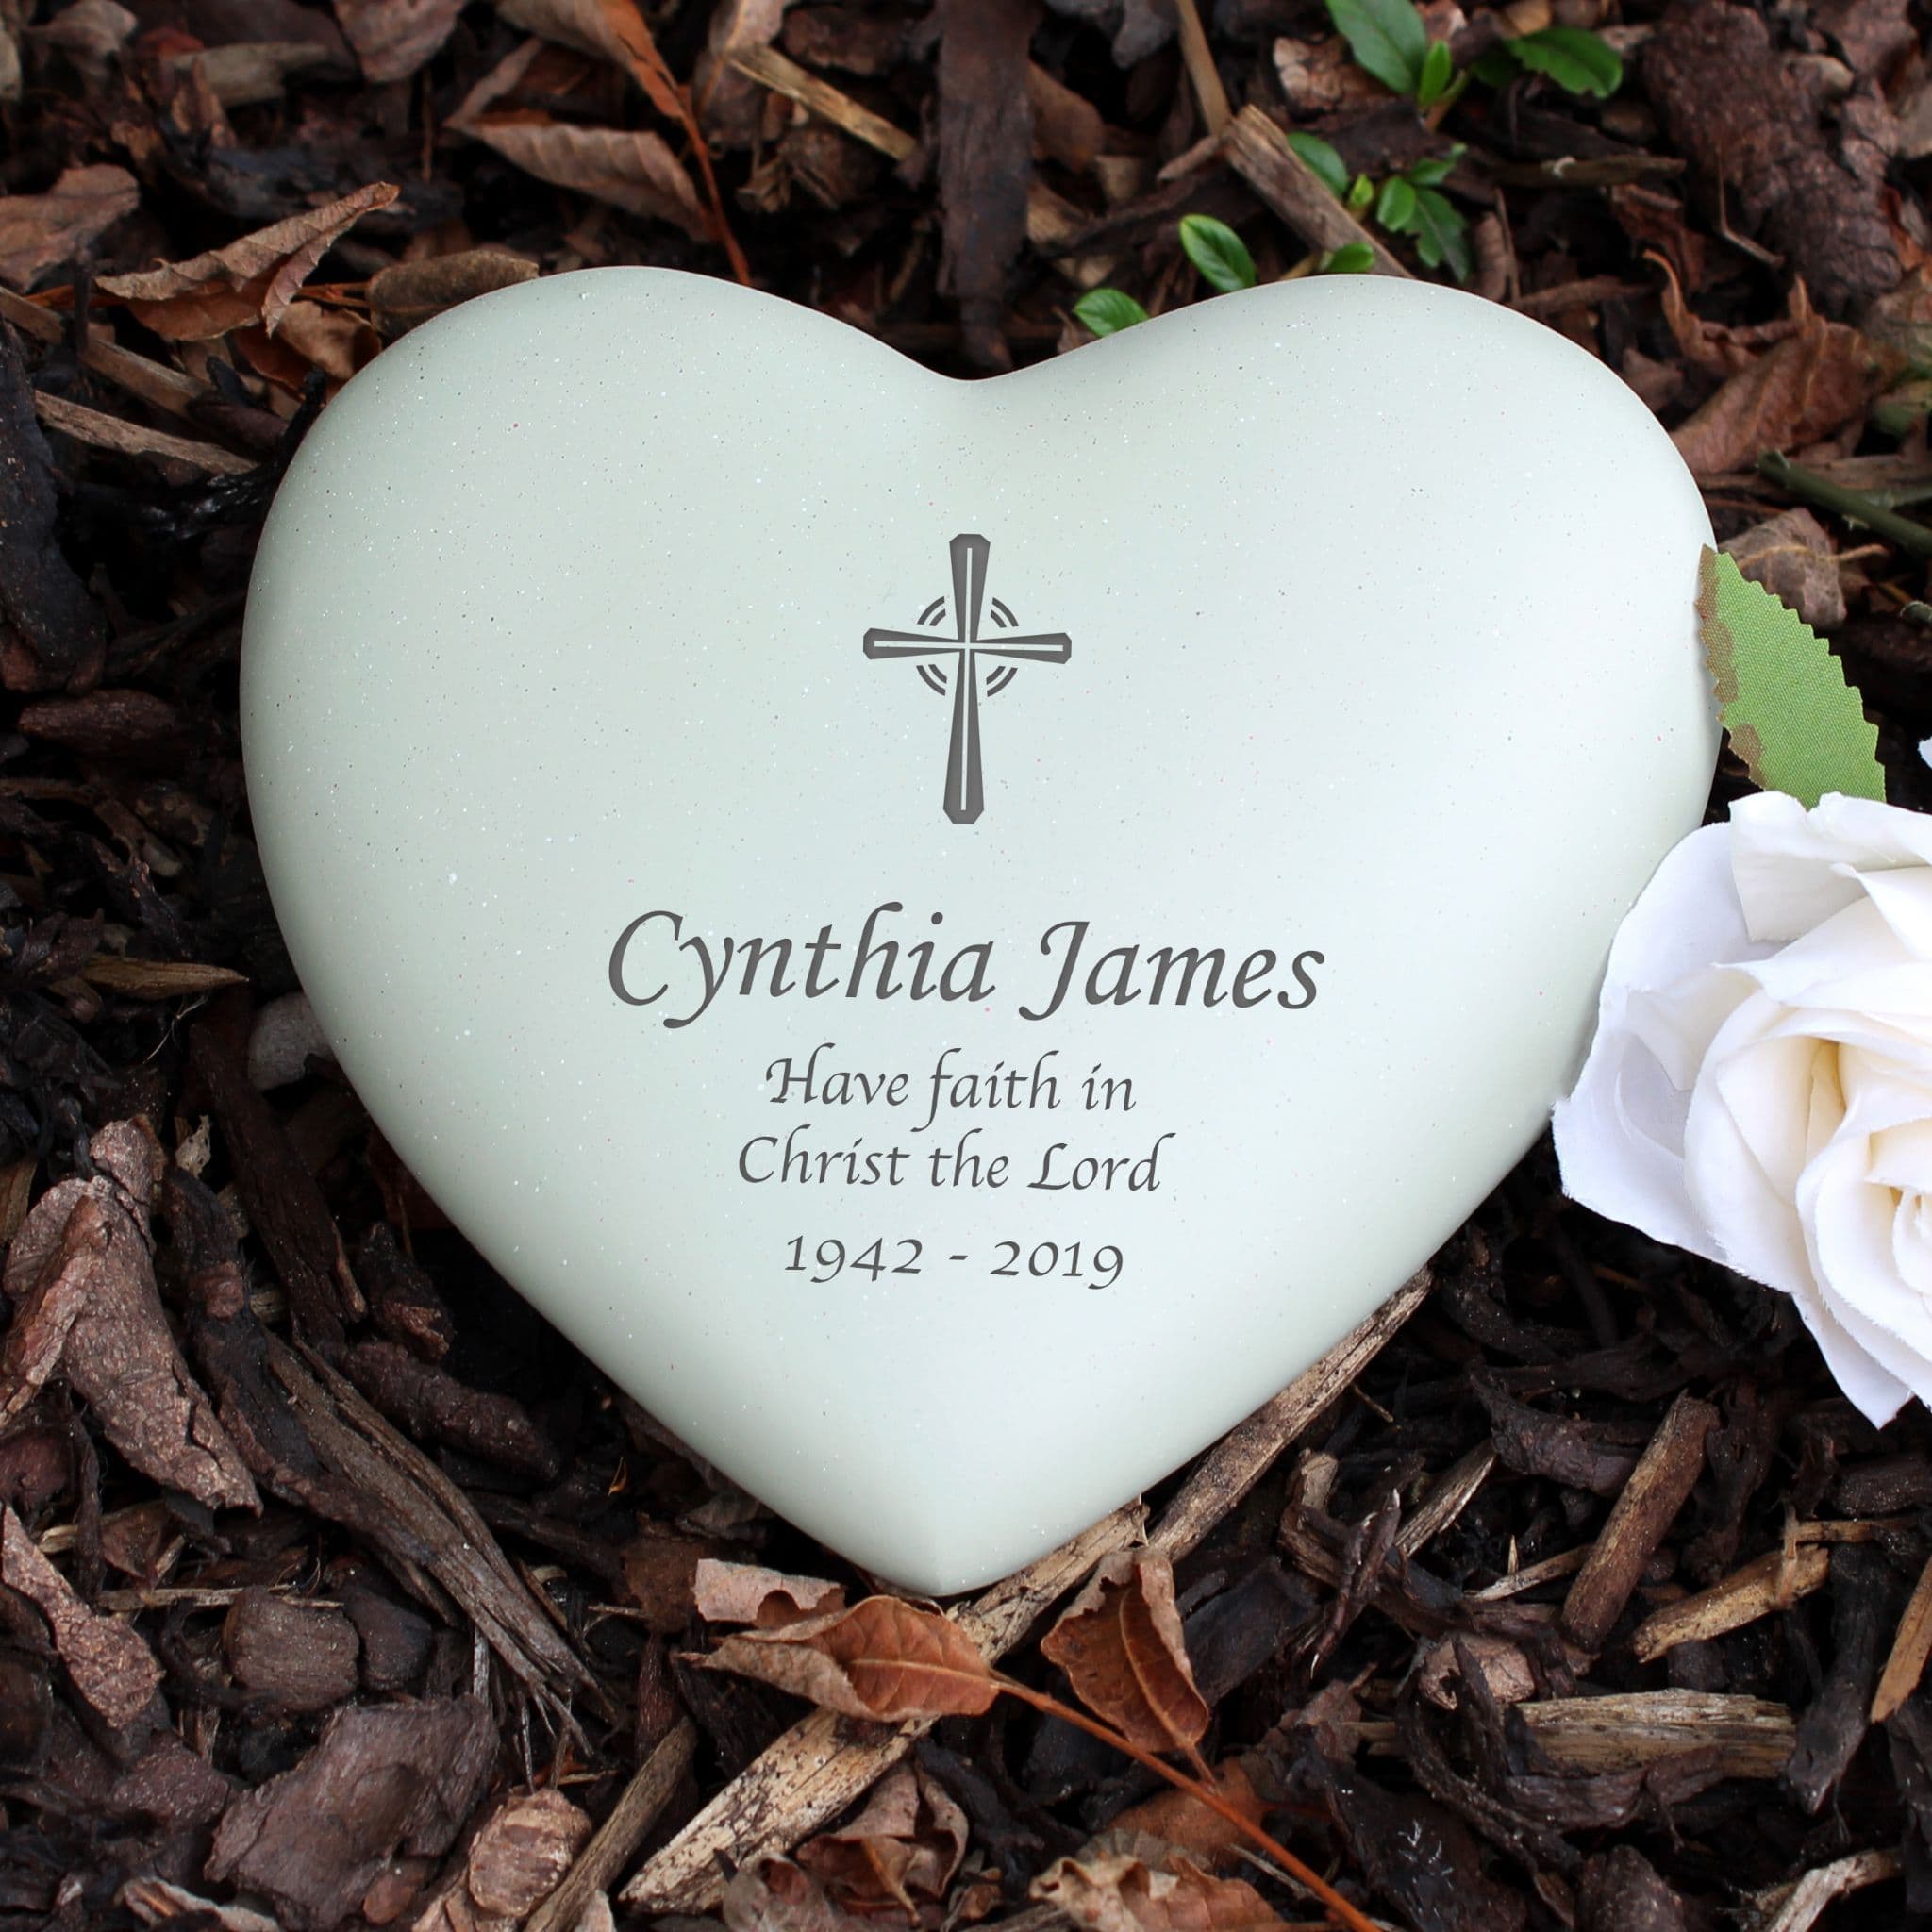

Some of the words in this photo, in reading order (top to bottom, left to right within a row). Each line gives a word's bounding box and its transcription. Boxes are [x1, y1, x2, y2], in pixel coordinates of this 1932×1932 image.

[608, 901, 997, 1029] Cynthia
[1018, 920, 1326, 1021] James
[765, 1041, 908, 1107] Have
[910, 1047, 1062, 1134] faith
[1081, 1062, 1138, 1111] in
[738, 1124, 912, 1186] Christ
[927, 1127, 1010, 1190] the
[1026, 1132, 1177, 1192] Lord
[783, 1235, 924, 1284] 1942
[990, 1241, 1124, 1291] 2019
